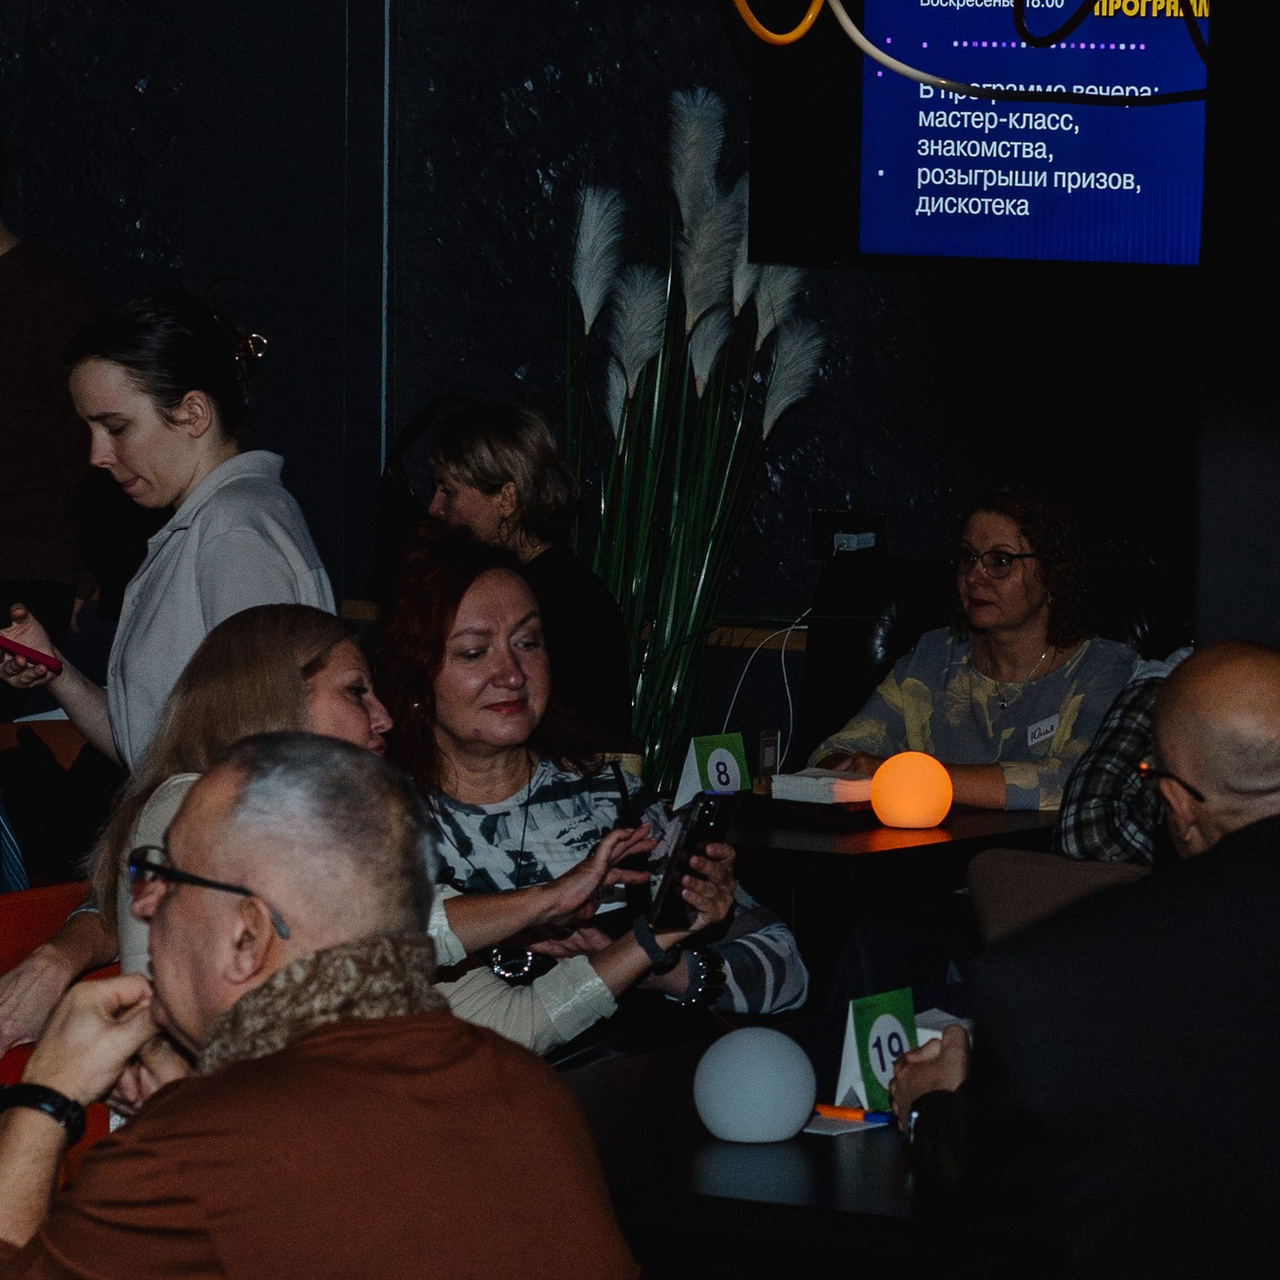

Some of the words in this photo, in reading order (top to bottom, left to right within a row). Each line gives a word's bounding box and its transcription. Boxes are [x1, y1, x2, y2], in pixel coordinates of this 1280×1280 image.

[918, 110, 1080, 134] мастер-класс,
[917, 139, 1054, 162] знакомства,
[917, 167, 1047, 191] розыгрыши
[1053, 171, 1142, 194] призов,
[915, 196, 1030, 217] дискотека
[716, 761, 730, 786] 8
[872, 1032, 904, 1072] 19
